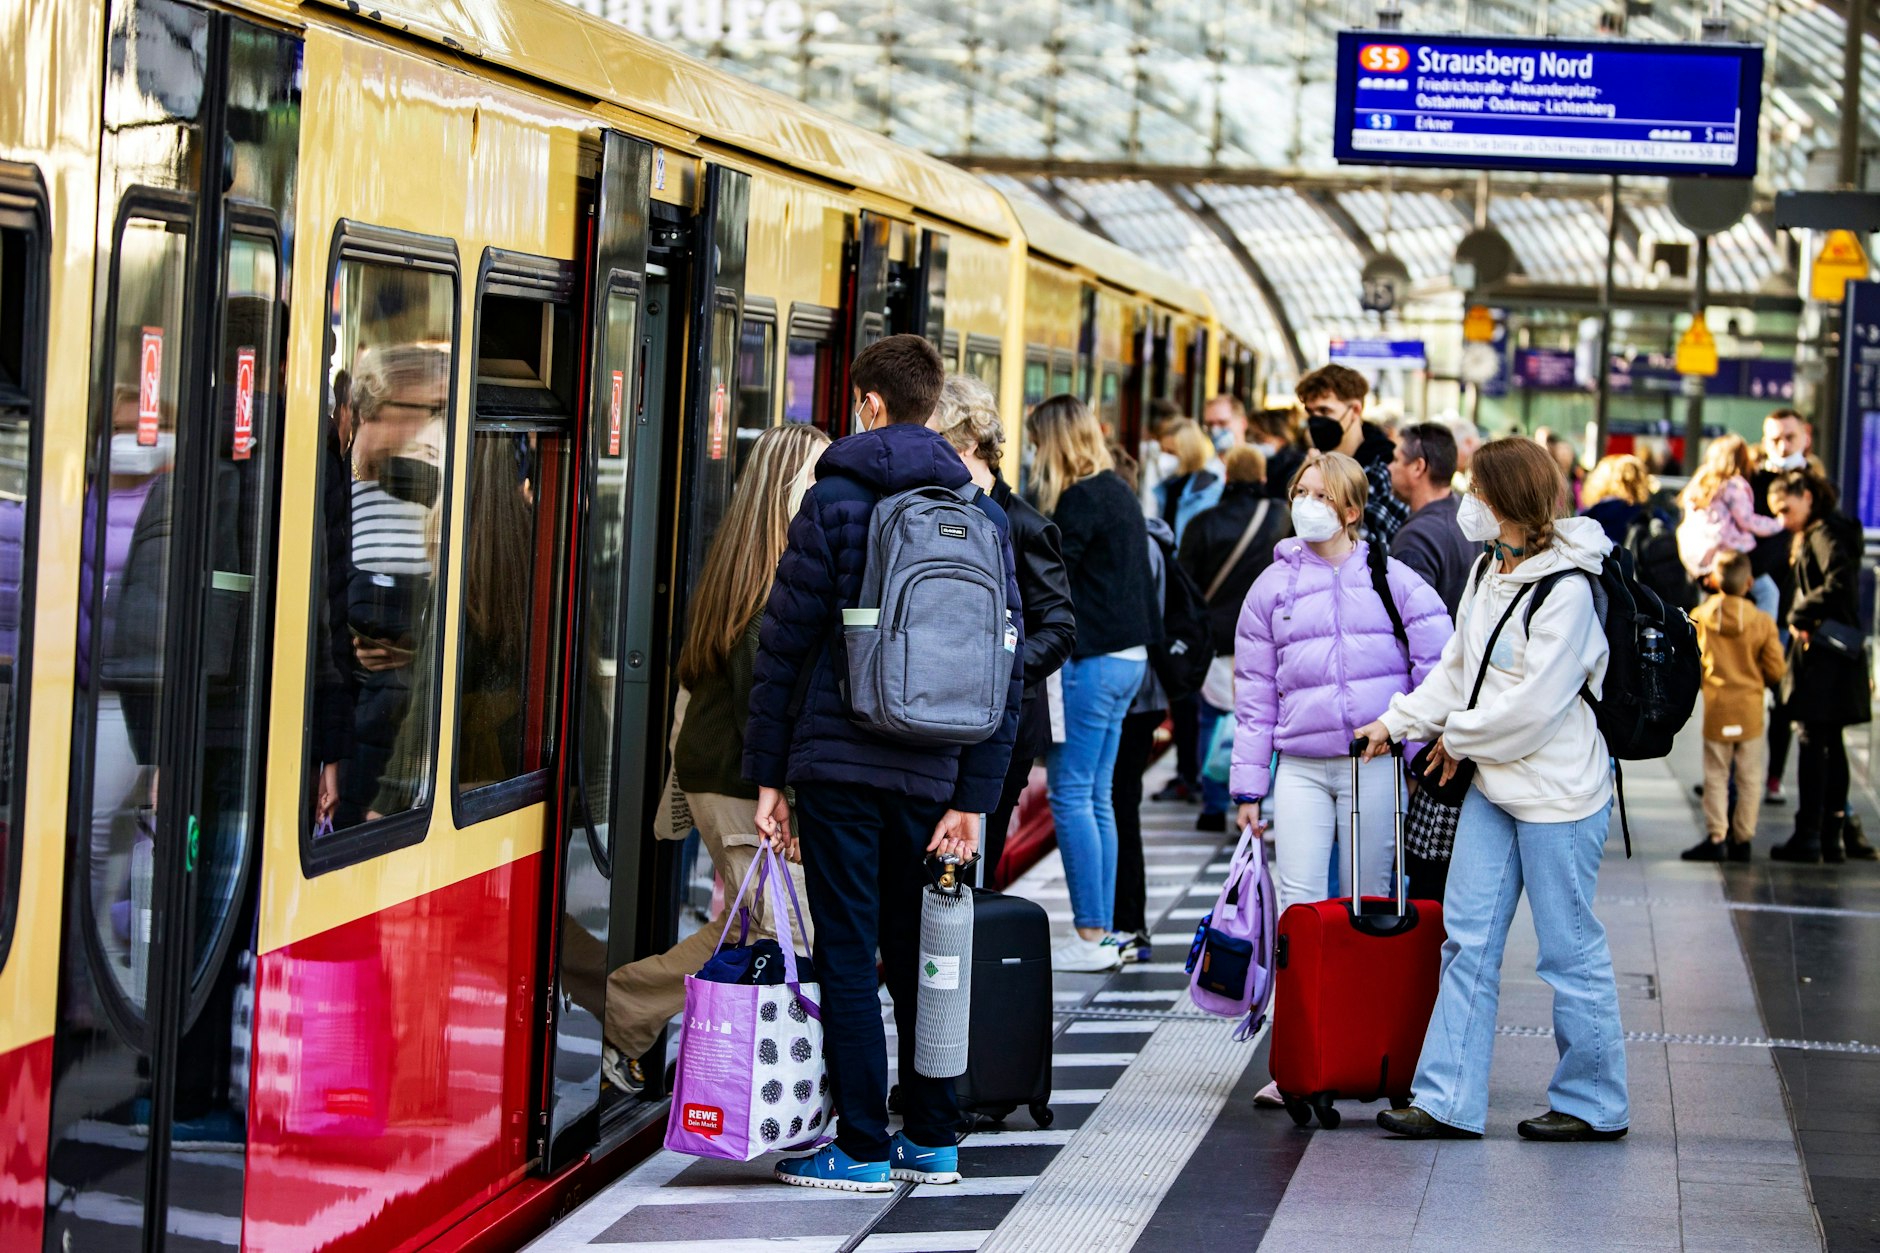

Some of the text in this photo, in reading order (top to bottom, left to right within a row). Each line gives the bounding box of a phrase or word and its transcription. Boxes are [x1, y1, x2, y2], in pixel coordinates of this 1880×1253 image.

[1417, 46, 1535, 82] Strausberg
[1540, 51, 1593, 79] Nord
[1415, 115, 1454, 131] Erkner
[1715, 129, 1735, 142] min
[690, 1017, 696, 1029] 2
[688, 1109, 718, 1121] REWE
[688, 1119, 718, 1129] Dein Markt
